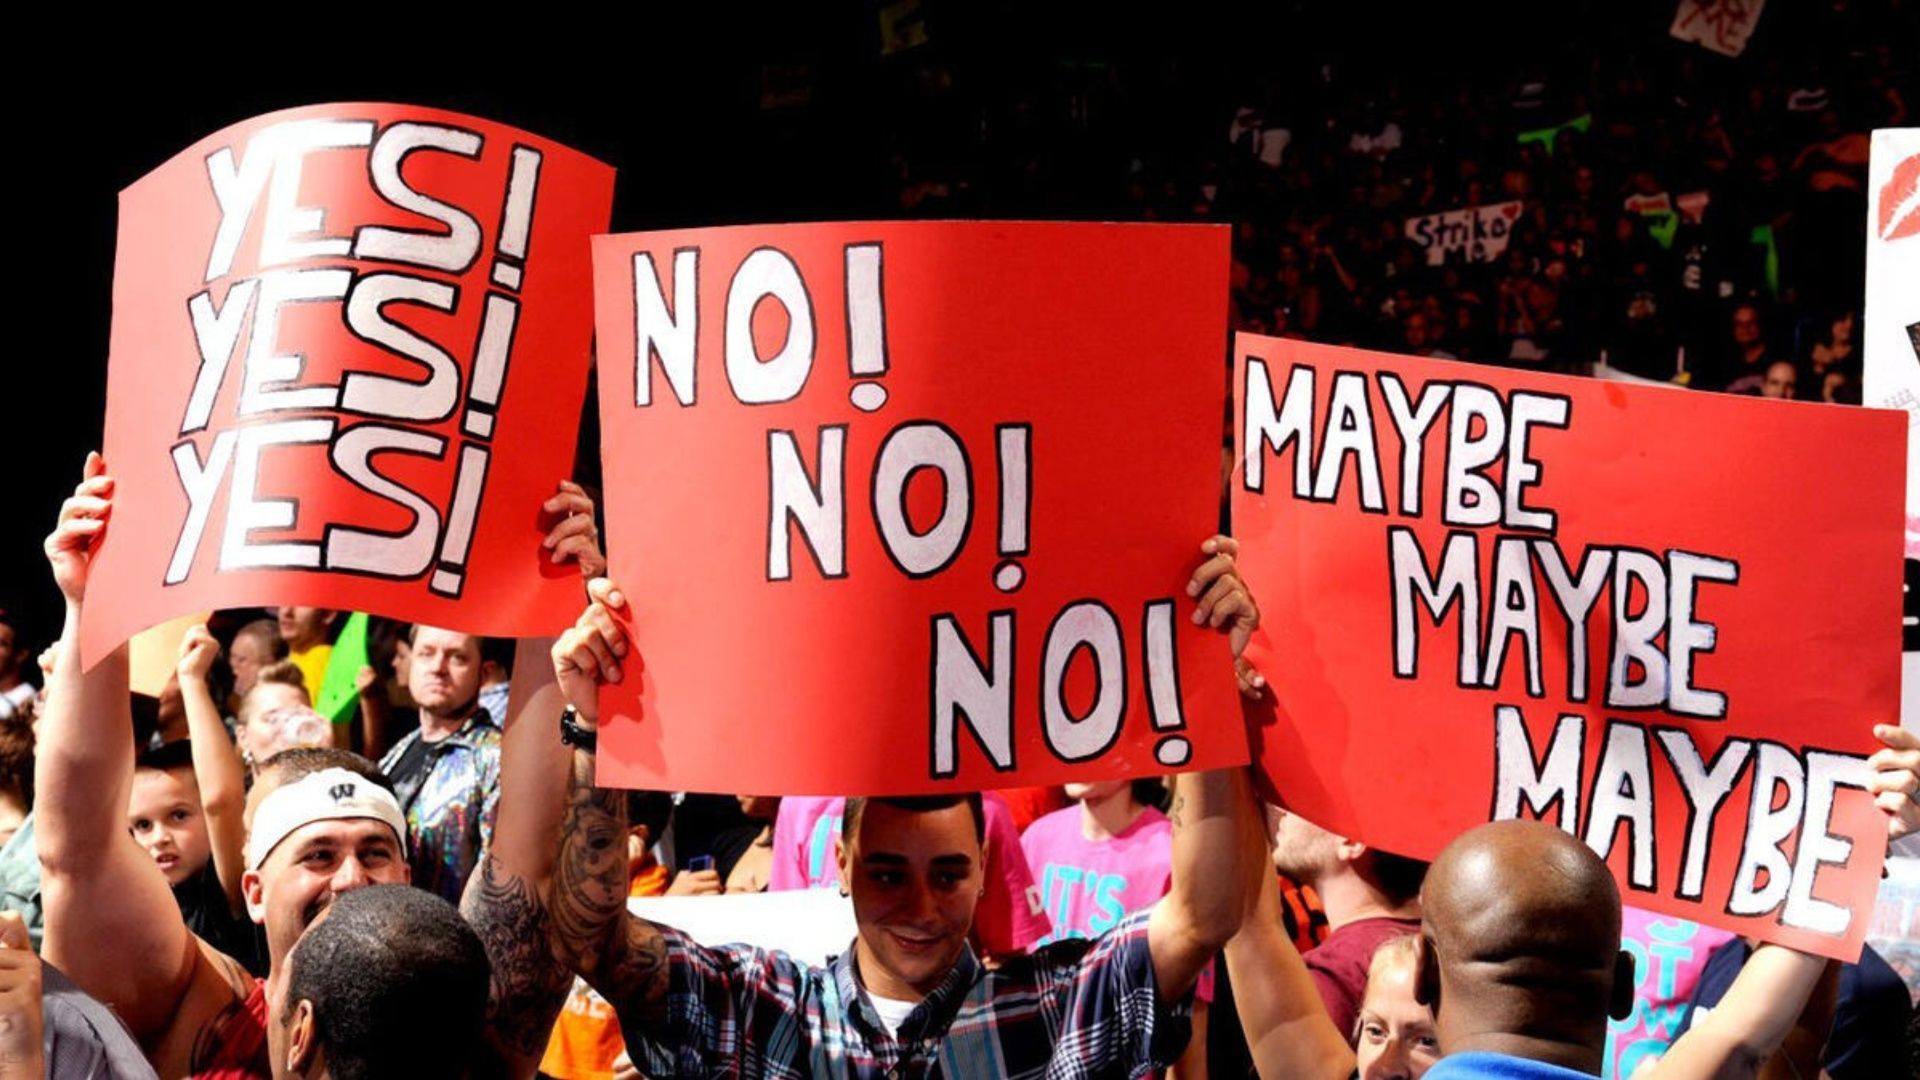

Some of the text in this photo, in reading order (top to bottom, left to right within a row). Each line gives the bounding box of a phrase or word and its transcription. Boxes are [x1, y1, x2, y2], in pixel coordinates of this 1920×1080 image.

[204, 118, 542, 293] YES!
[179, 267, 521, 441] YES!
[632, 241, 890, 412] NO!
[162, 418, 491, 600] YES!
[766, 420, 1032, 593] NO!
[1242, 356, 1571, 531] MAYBE
[929, 599, 1192, 779] NO!
[1387, 526, 1738, 719] MAYBE
[1042, 864, 1127, 934] IT'S
[1489, 704, 1877, 936] MAYBE
